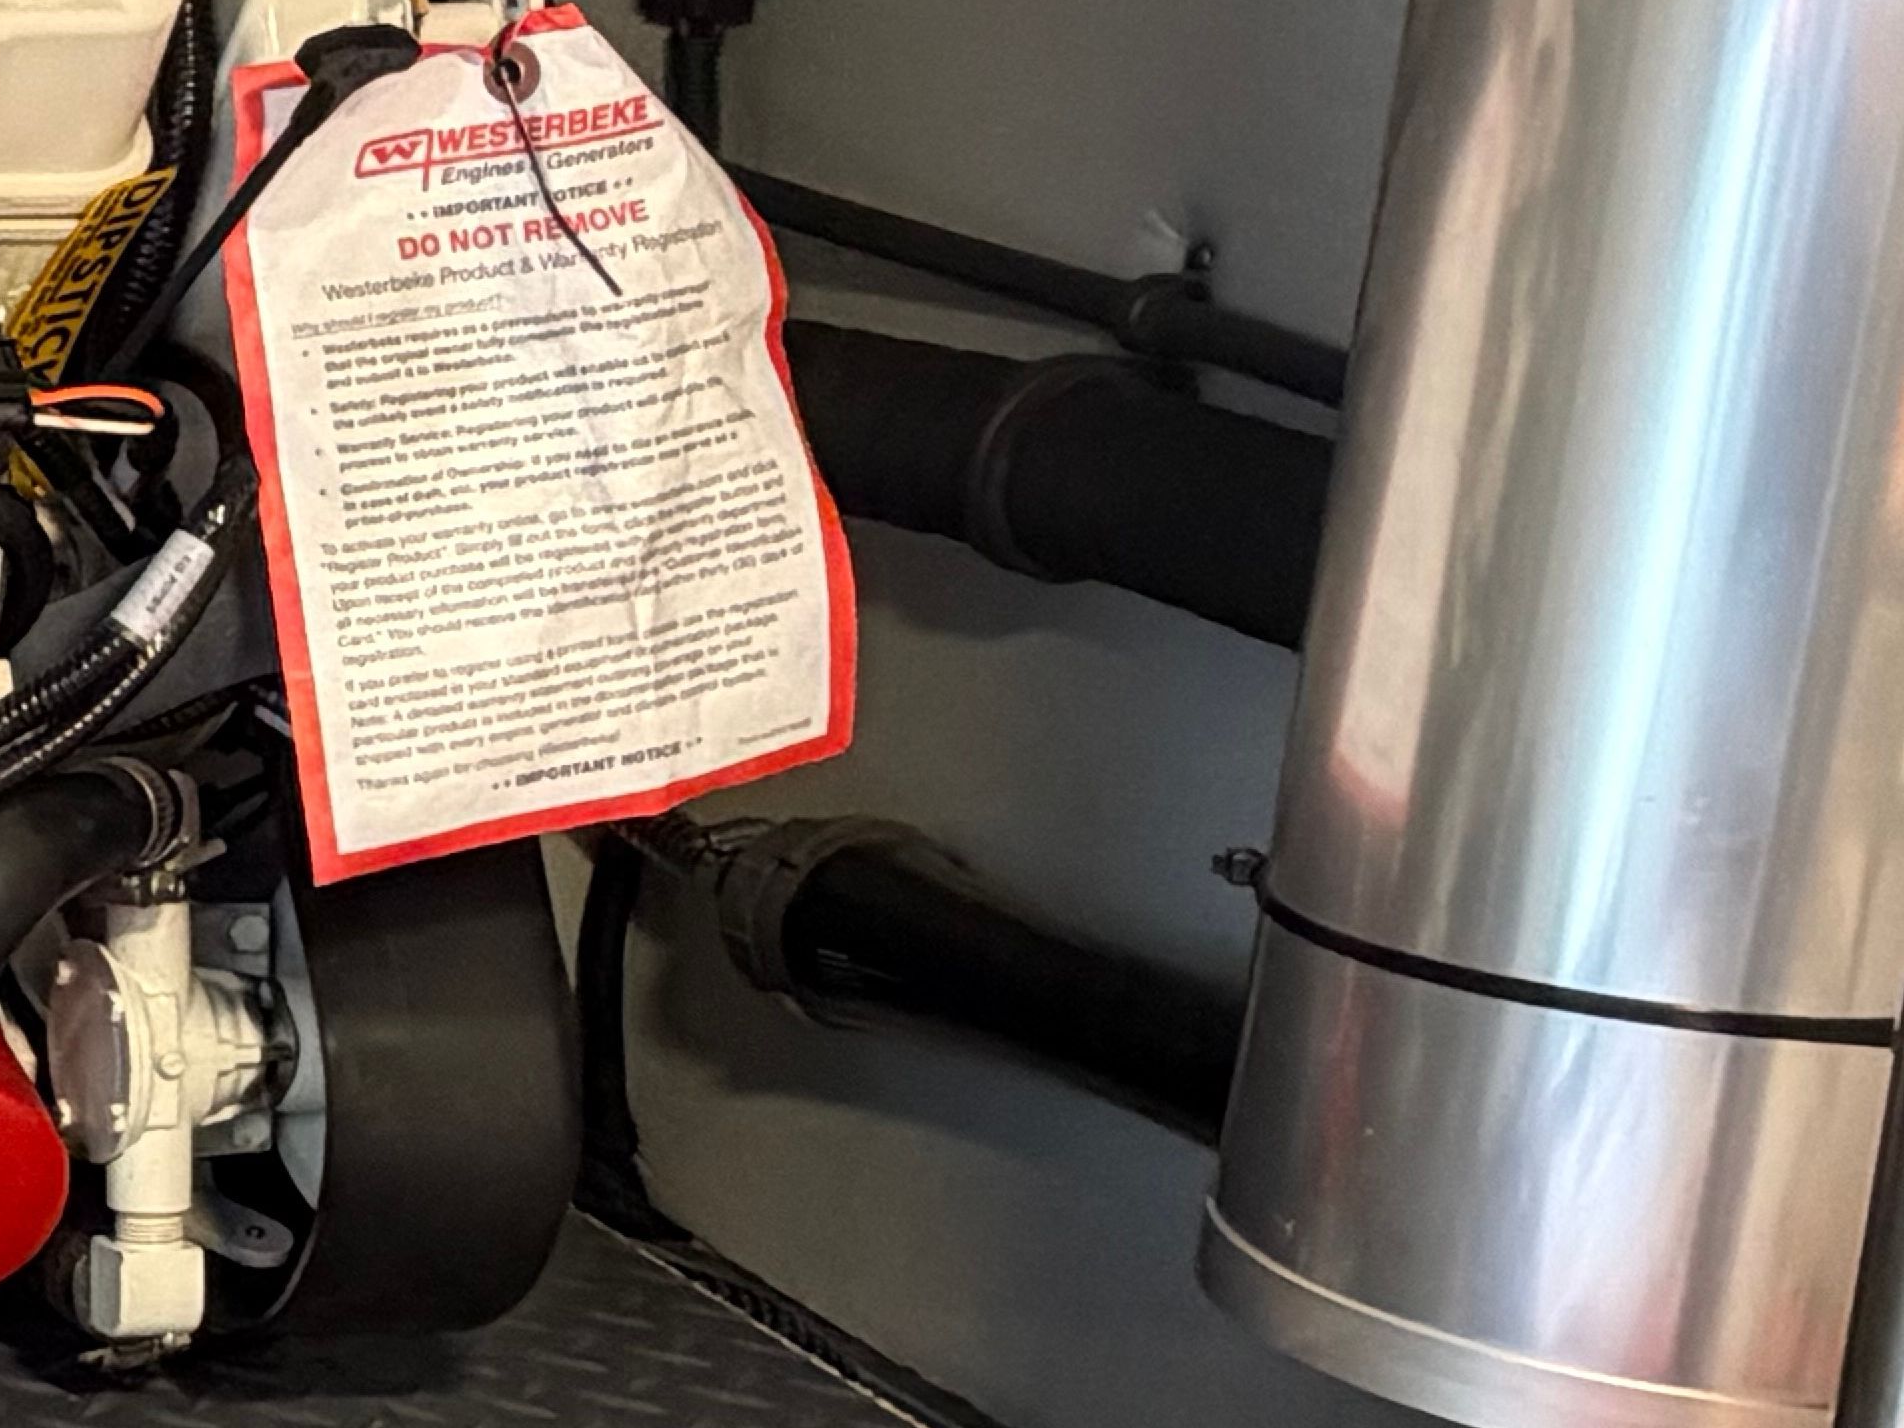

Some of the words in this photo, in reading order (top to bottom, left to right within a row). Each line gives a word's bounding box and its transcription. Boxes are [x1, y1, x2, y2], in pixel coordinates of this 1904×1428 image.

[436, 96, 649, 154] WESTERBEKE
[441, 160, 524, 185] Engines
[546, 136, 653, 170] Generators
[433, 193, 538, 218] IMPORTANT
[544, 180, 607, 203] OTICE
[398, 233, 440, 260] DO
[449, 223, 513, 253] NOT
[523, 199, 649, 243] REMOVE
[321, 271, 435, 301] Westerbeke
[439, 259, 516, 285] Product
[520, 255, 534, 274] &
[515, 755, 616, 787] IMPORTANT
[620, 740, 681, 766] NOTICE
